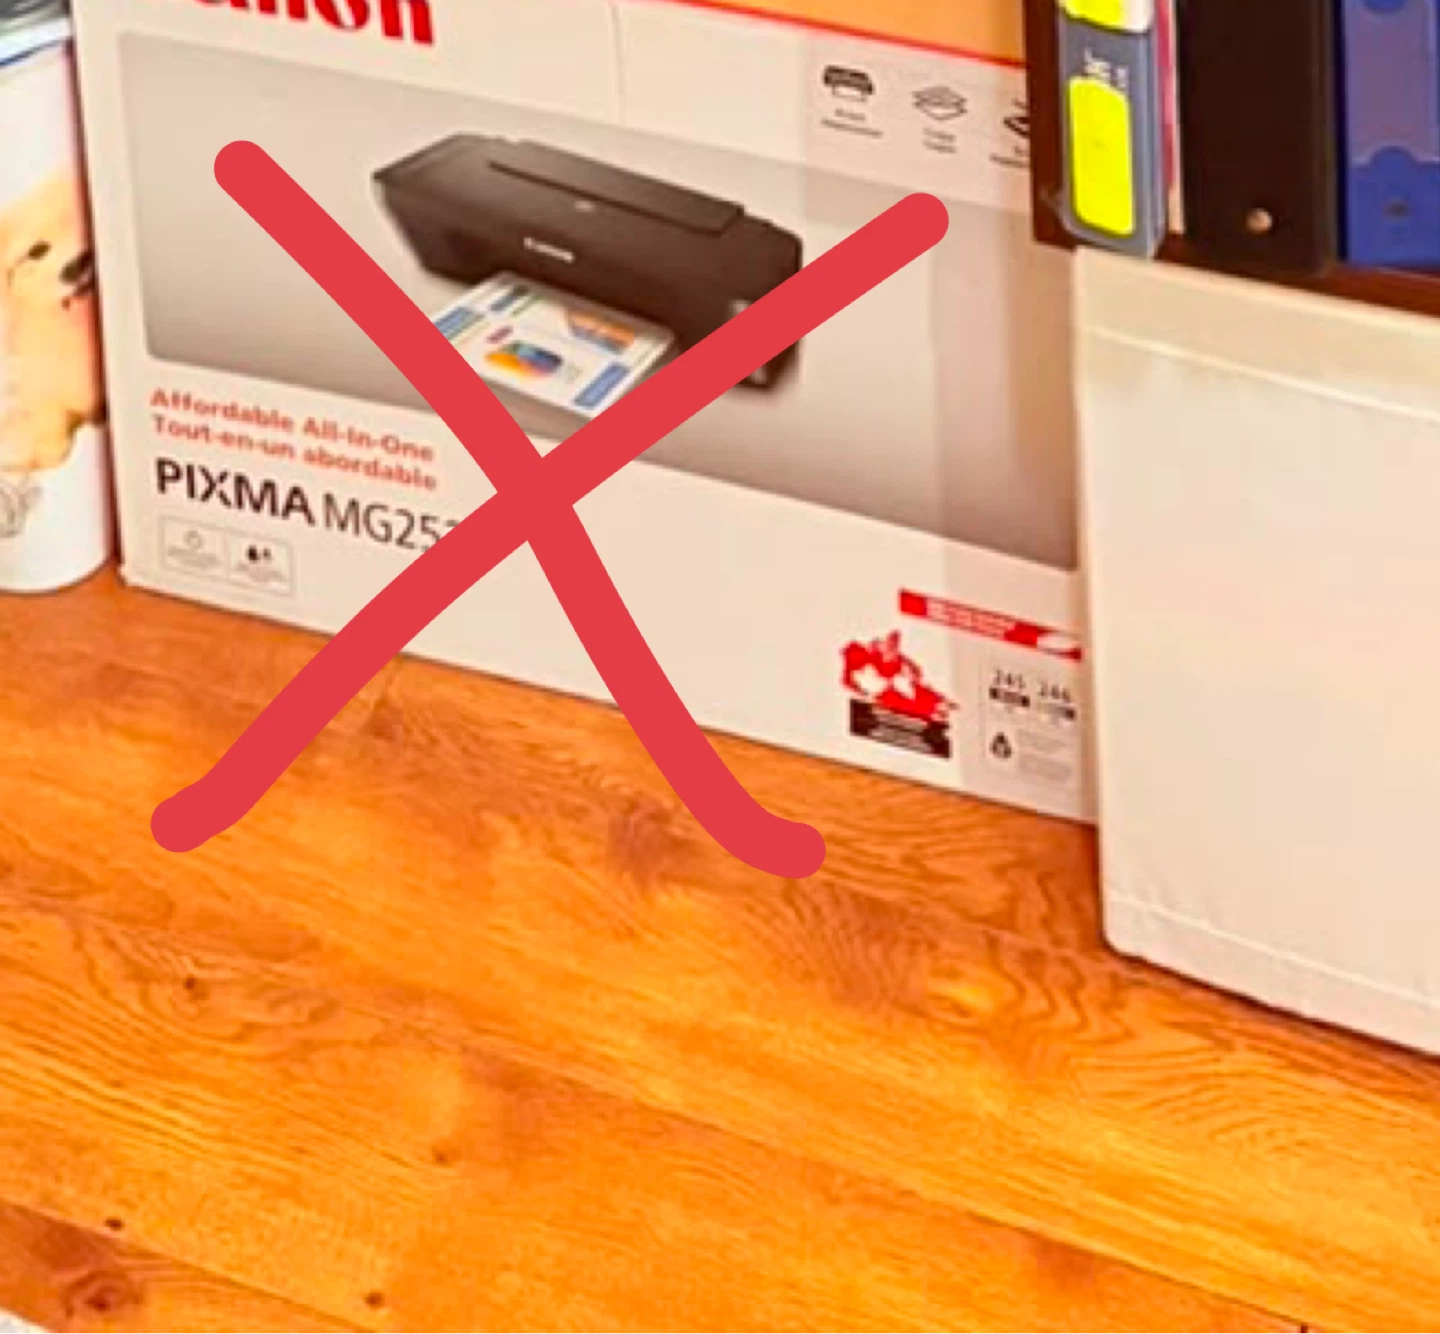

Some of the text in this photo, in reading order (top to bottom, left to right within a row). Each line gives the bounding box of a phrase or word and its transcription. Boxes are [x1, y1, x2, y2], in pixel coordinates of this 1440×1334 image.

[149, 387, 435, 462] Affordable All-In-One
[151, 412, 438, 492] Tout-en-un abordable
[155, 456, 461, 553] PIXMA MG25
